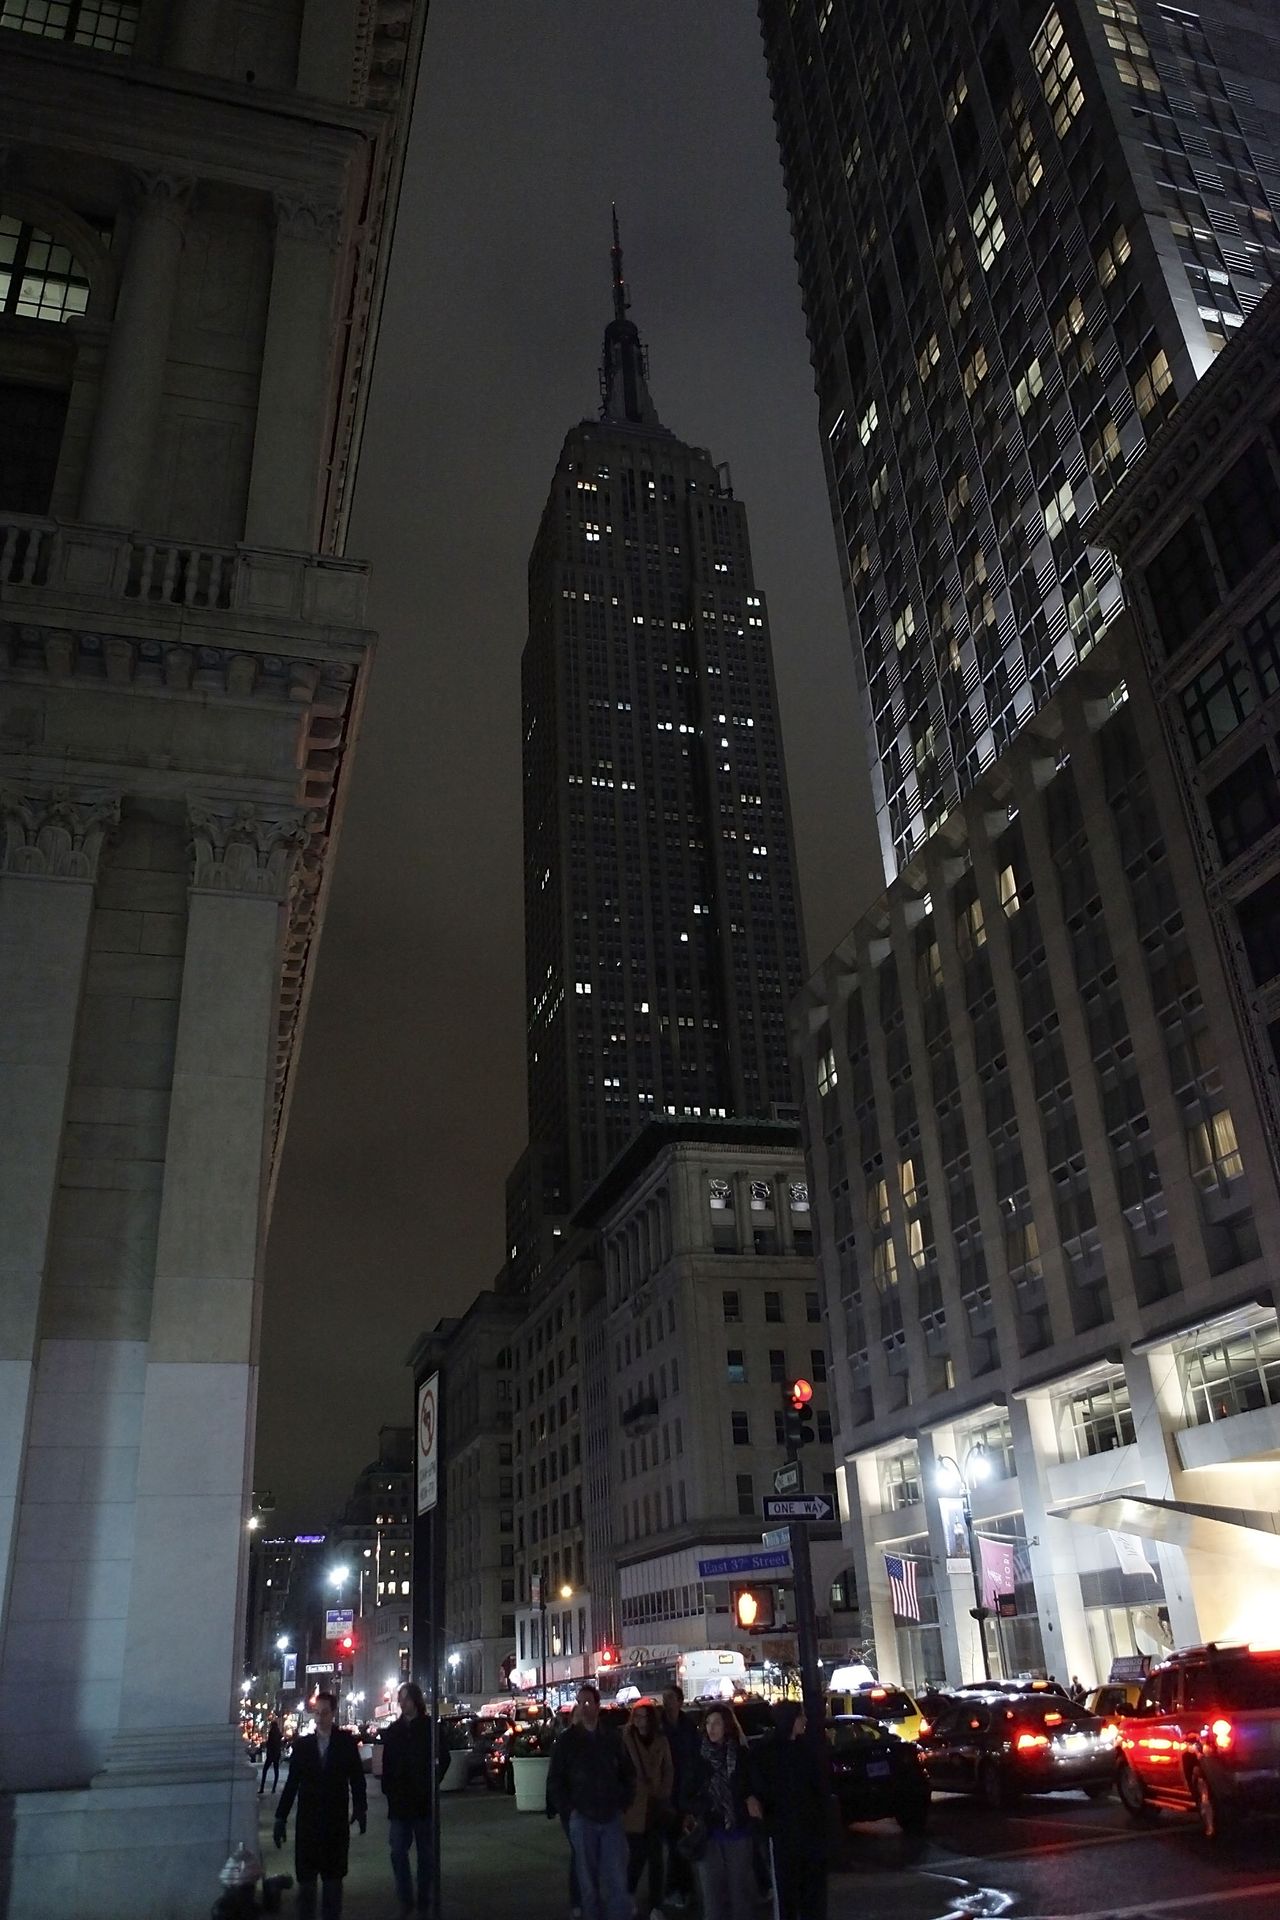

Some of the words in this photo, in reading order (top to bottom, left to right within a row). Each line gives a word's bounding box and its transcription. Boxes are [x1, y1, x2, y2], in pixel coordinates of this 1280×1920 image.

[774, 1503, 795, 1513] ONE
[804, 1503, 824, 1513] WAY
[703, 1561, 727, 1574] East
[752, 1554, 786, 1567] Street
[1002, 1553, 1012, 1587] FIORI
